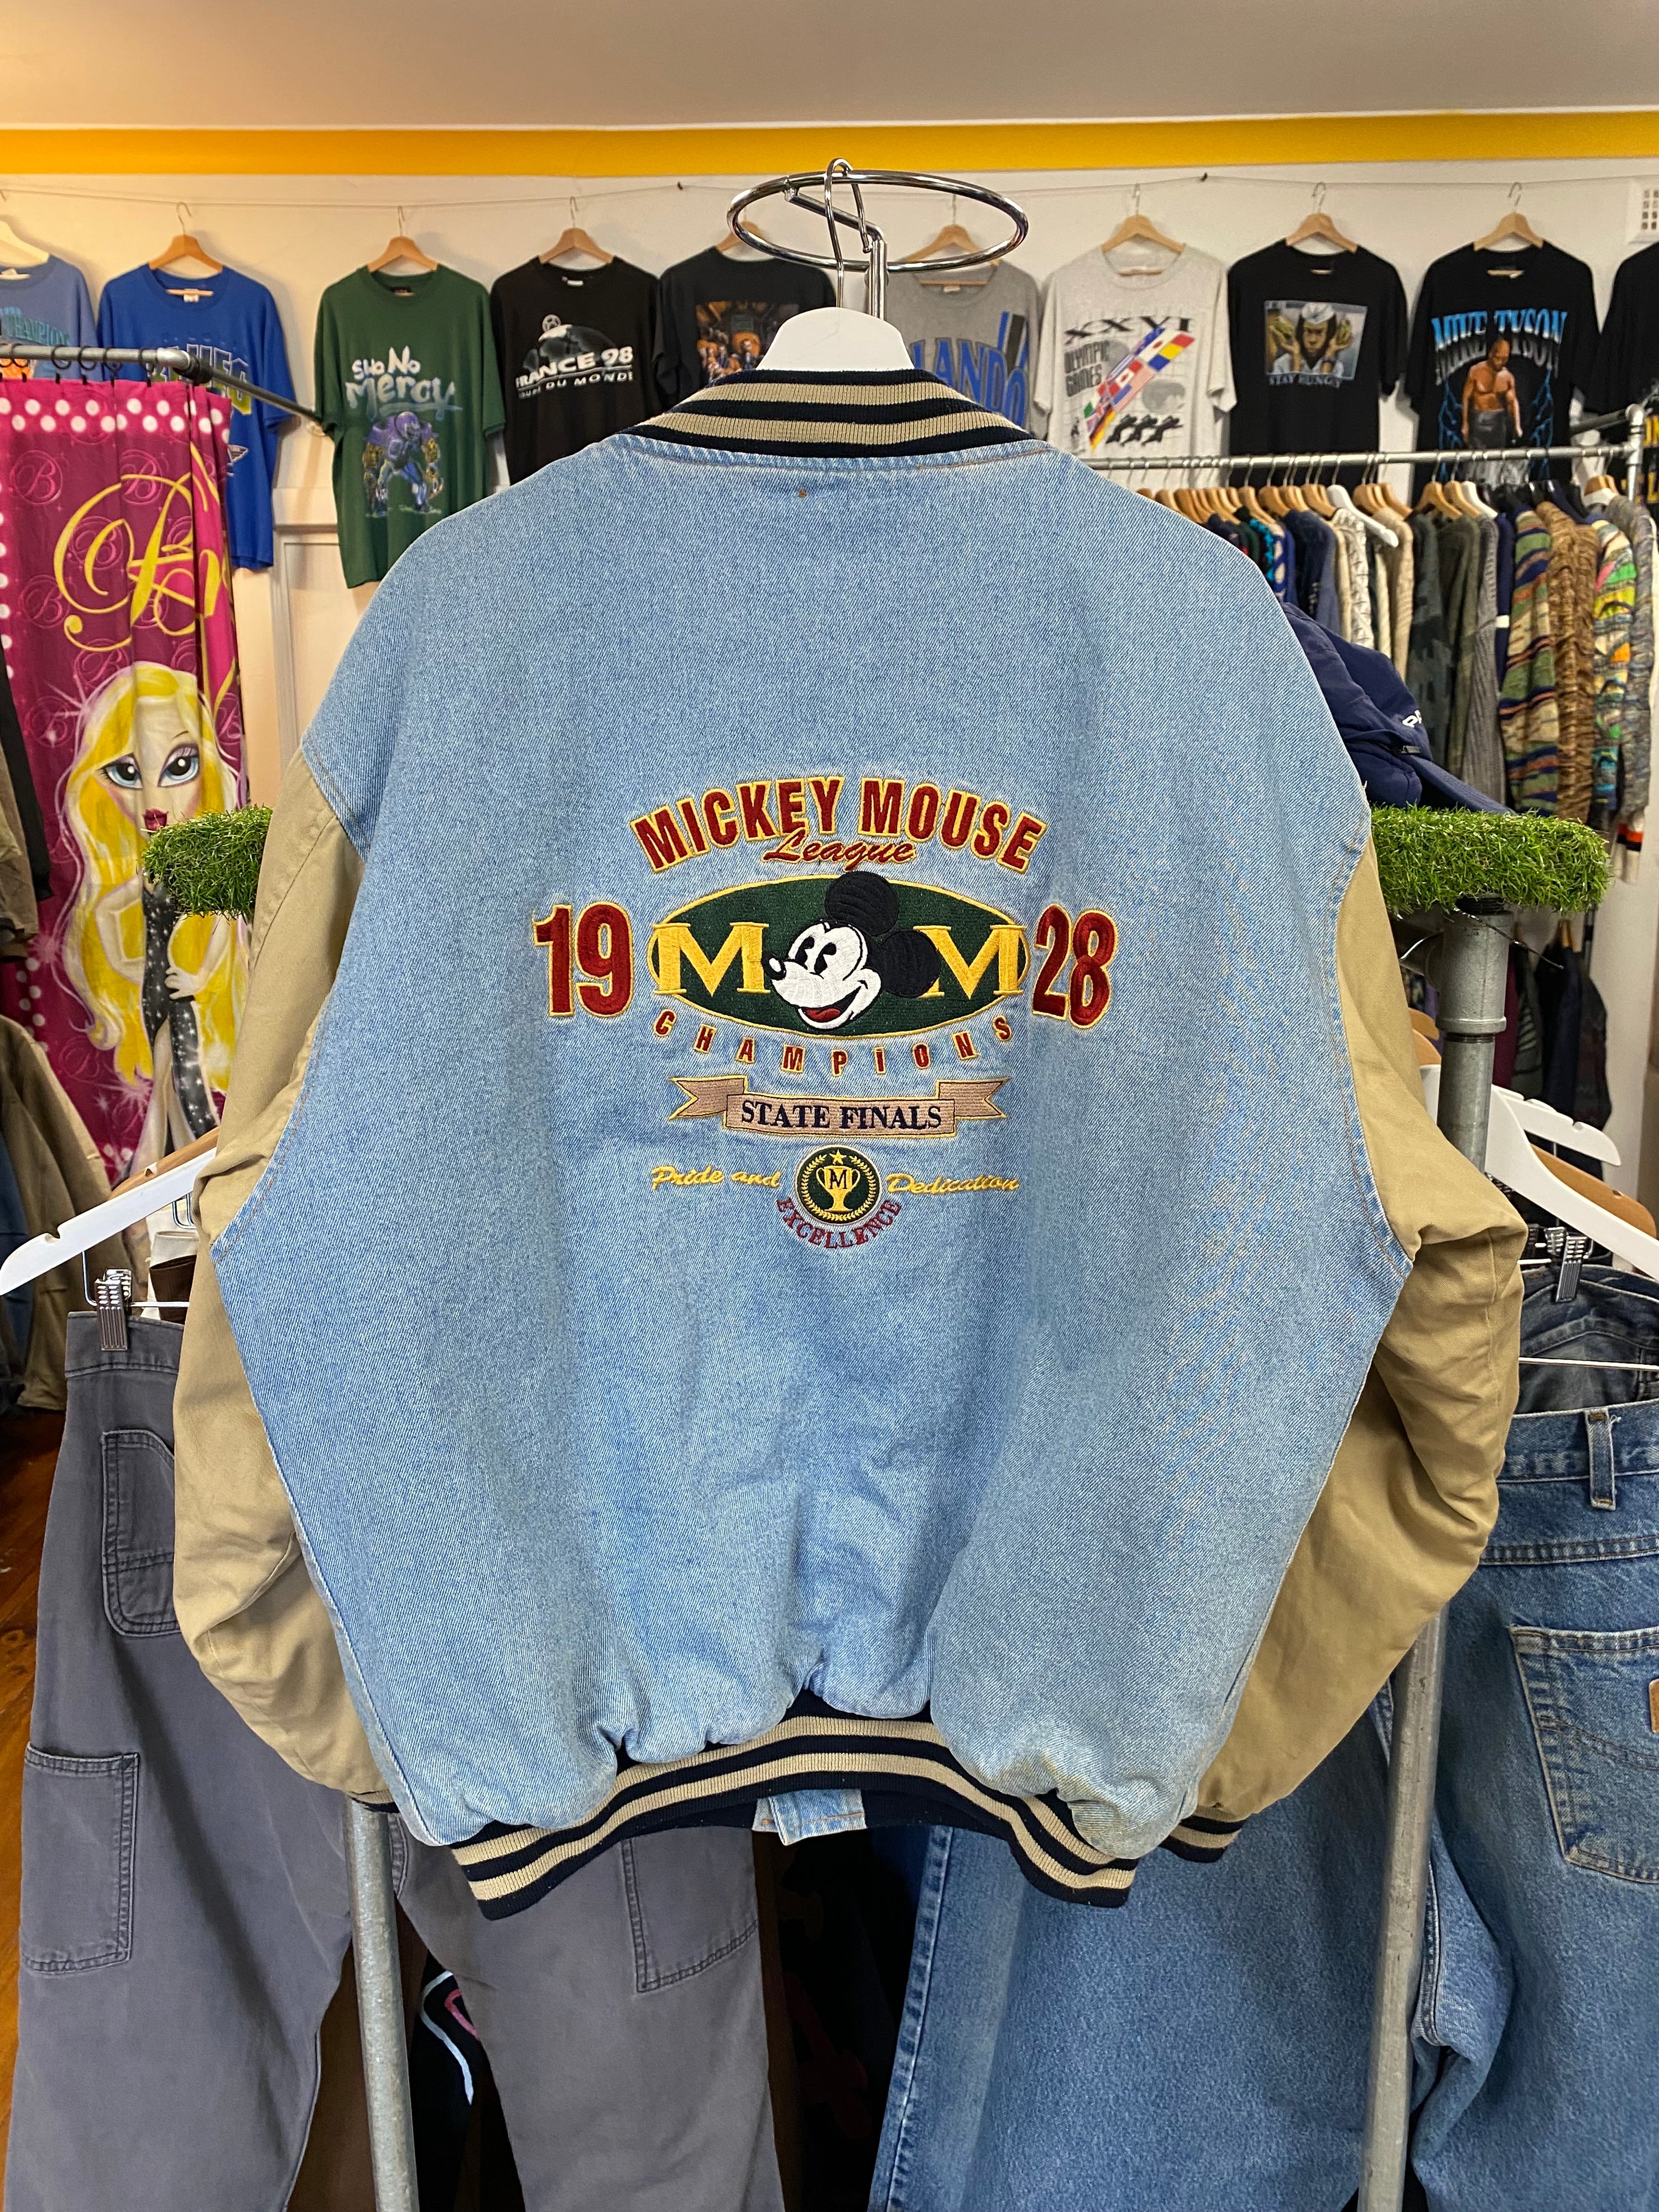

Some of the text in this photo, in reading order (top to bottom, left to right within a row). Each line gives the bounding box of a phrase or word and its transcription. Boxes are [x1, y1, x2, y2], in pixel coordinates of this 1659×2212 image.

[1494, 308, 1568, 344] TYSON
[601, 346, 633, 364] 98
[546, 379, 567, 390] DU
[630, 776, 1047, 874] MICKEY MOUSE
[761, 827, 917, 872] League
[533, 901, 634, 1018] 19
[653, 922, 1026, 1000] M M
[1032, 902, 1118, 1030] 28
[653, 1009, 1012, 1077] CHAMPIONS
[741, 1099, 941, 1130] STATE FINALS
[651, 1165, 1020, 1194] Pride and Dedication
[776, 1198, 902, 1249] EXCELLENCE
